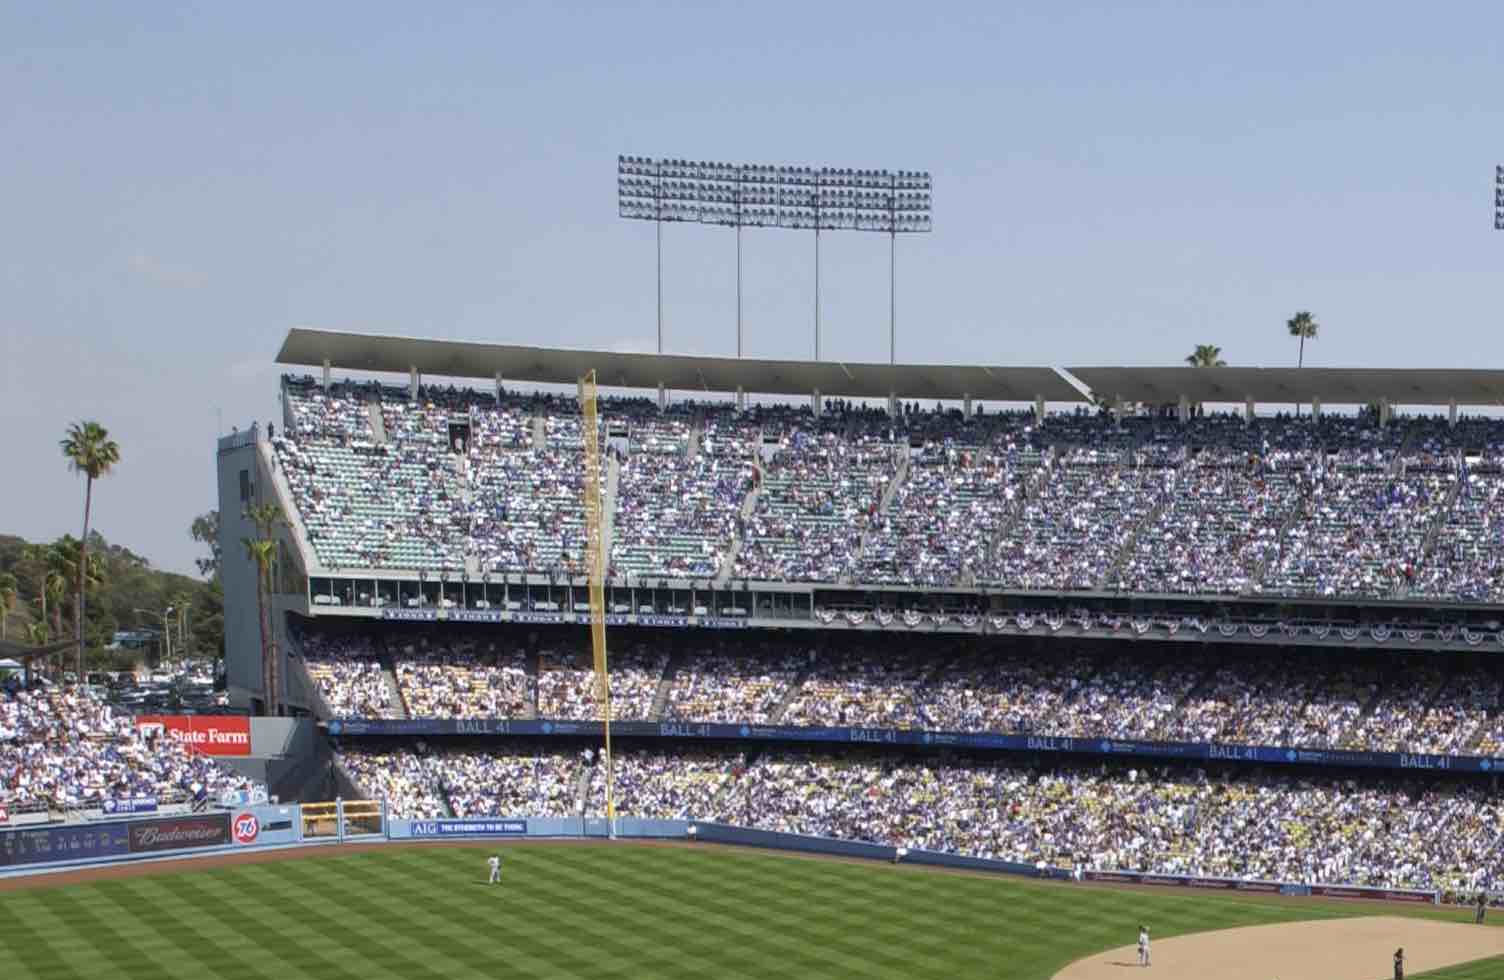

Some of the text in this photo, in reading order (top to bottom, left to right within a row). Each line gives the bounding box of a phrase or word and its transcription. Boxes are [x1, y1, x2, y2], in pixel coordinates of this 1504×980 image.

[456, 719, 491, 733] BALL
[660, 723, 694, 737] BALL
[169, 728, 248, 744] State Farm
[850, 729, 880, 742] BALL
[1028, 736, 1057, 750] BALL
[1209, 745, 1241, 758] BALL
[1401, 753, 1433, 767] BALL
[238, 816, 256, 838] 76
[414, 823, 436, 834] AIG
[134, 825, 224, 846] Budweiser
